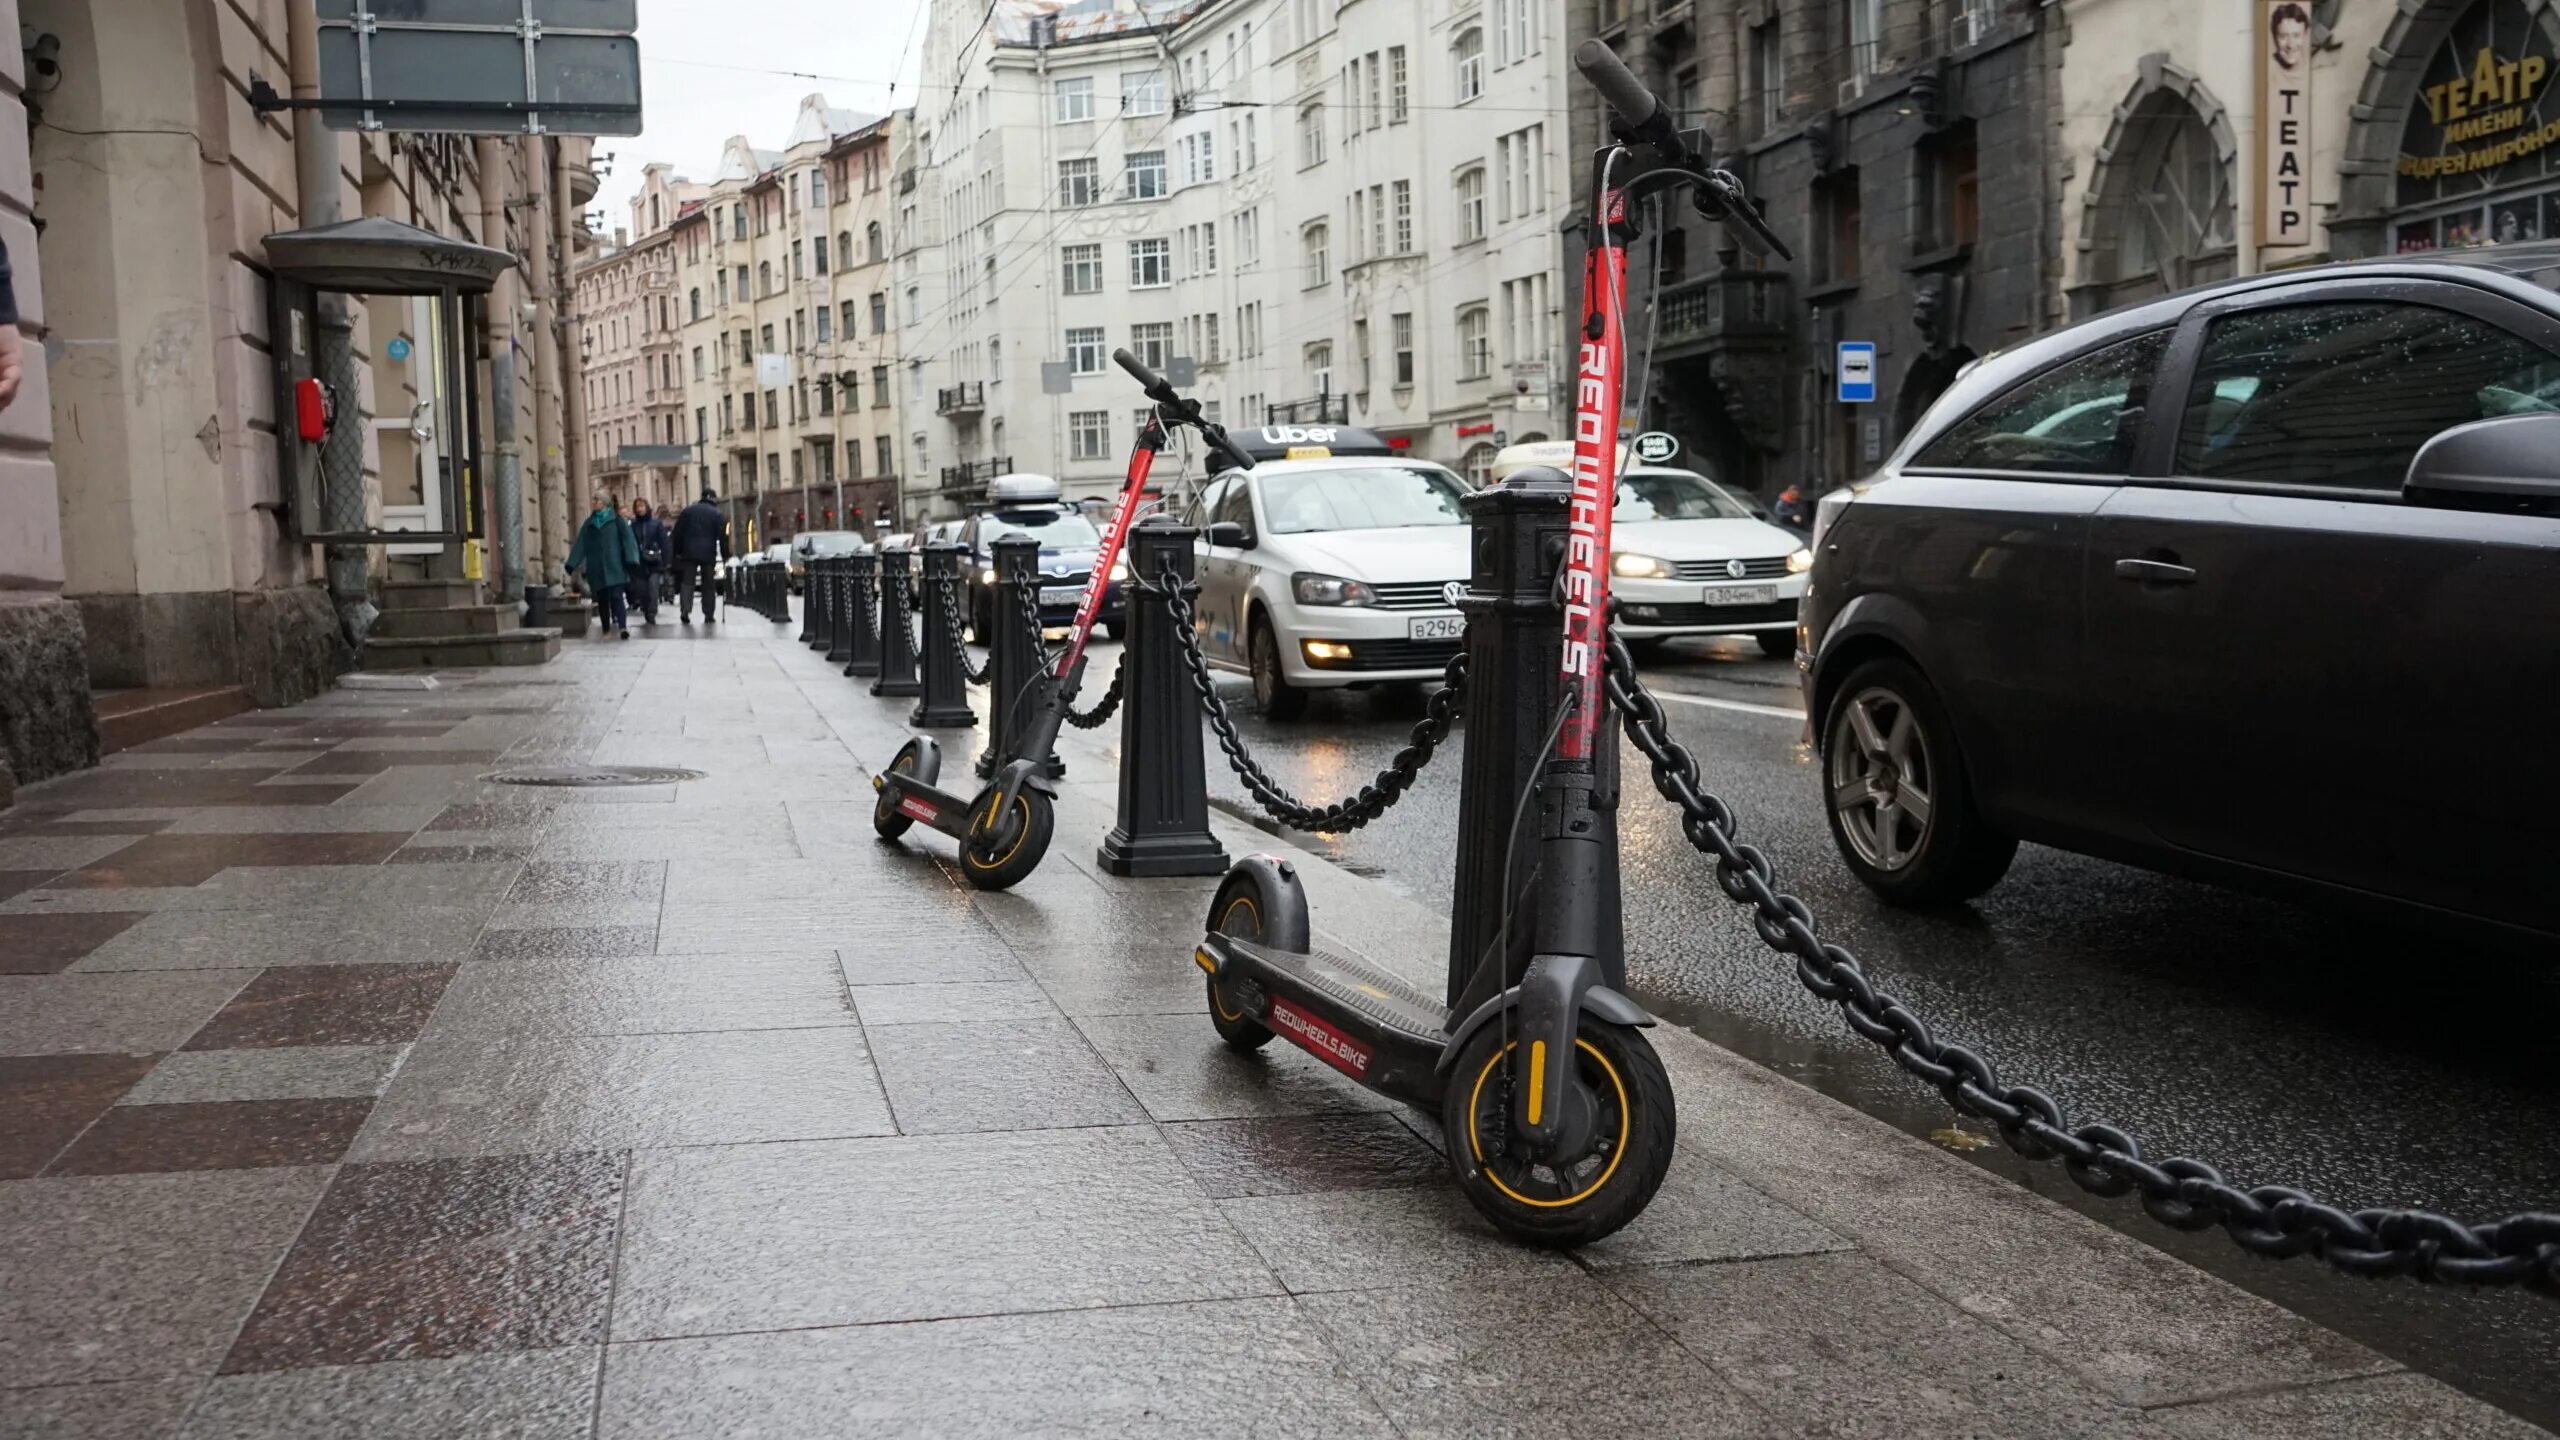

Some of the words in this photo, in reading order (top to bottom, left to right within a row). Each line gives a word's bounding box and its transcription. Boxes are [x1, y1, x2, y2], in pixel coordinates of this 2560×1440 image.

[2426, 47, 2546, 125] ТЕАТР
[2446, 106, 2523, 144] ИМЕНИ
[2278, 89, 2300, 235] ТЕАТР
[1261, 426, 1337, 444] Uber
[1273, 1004, 1368, 1071] REDWHEELS.BIKE
